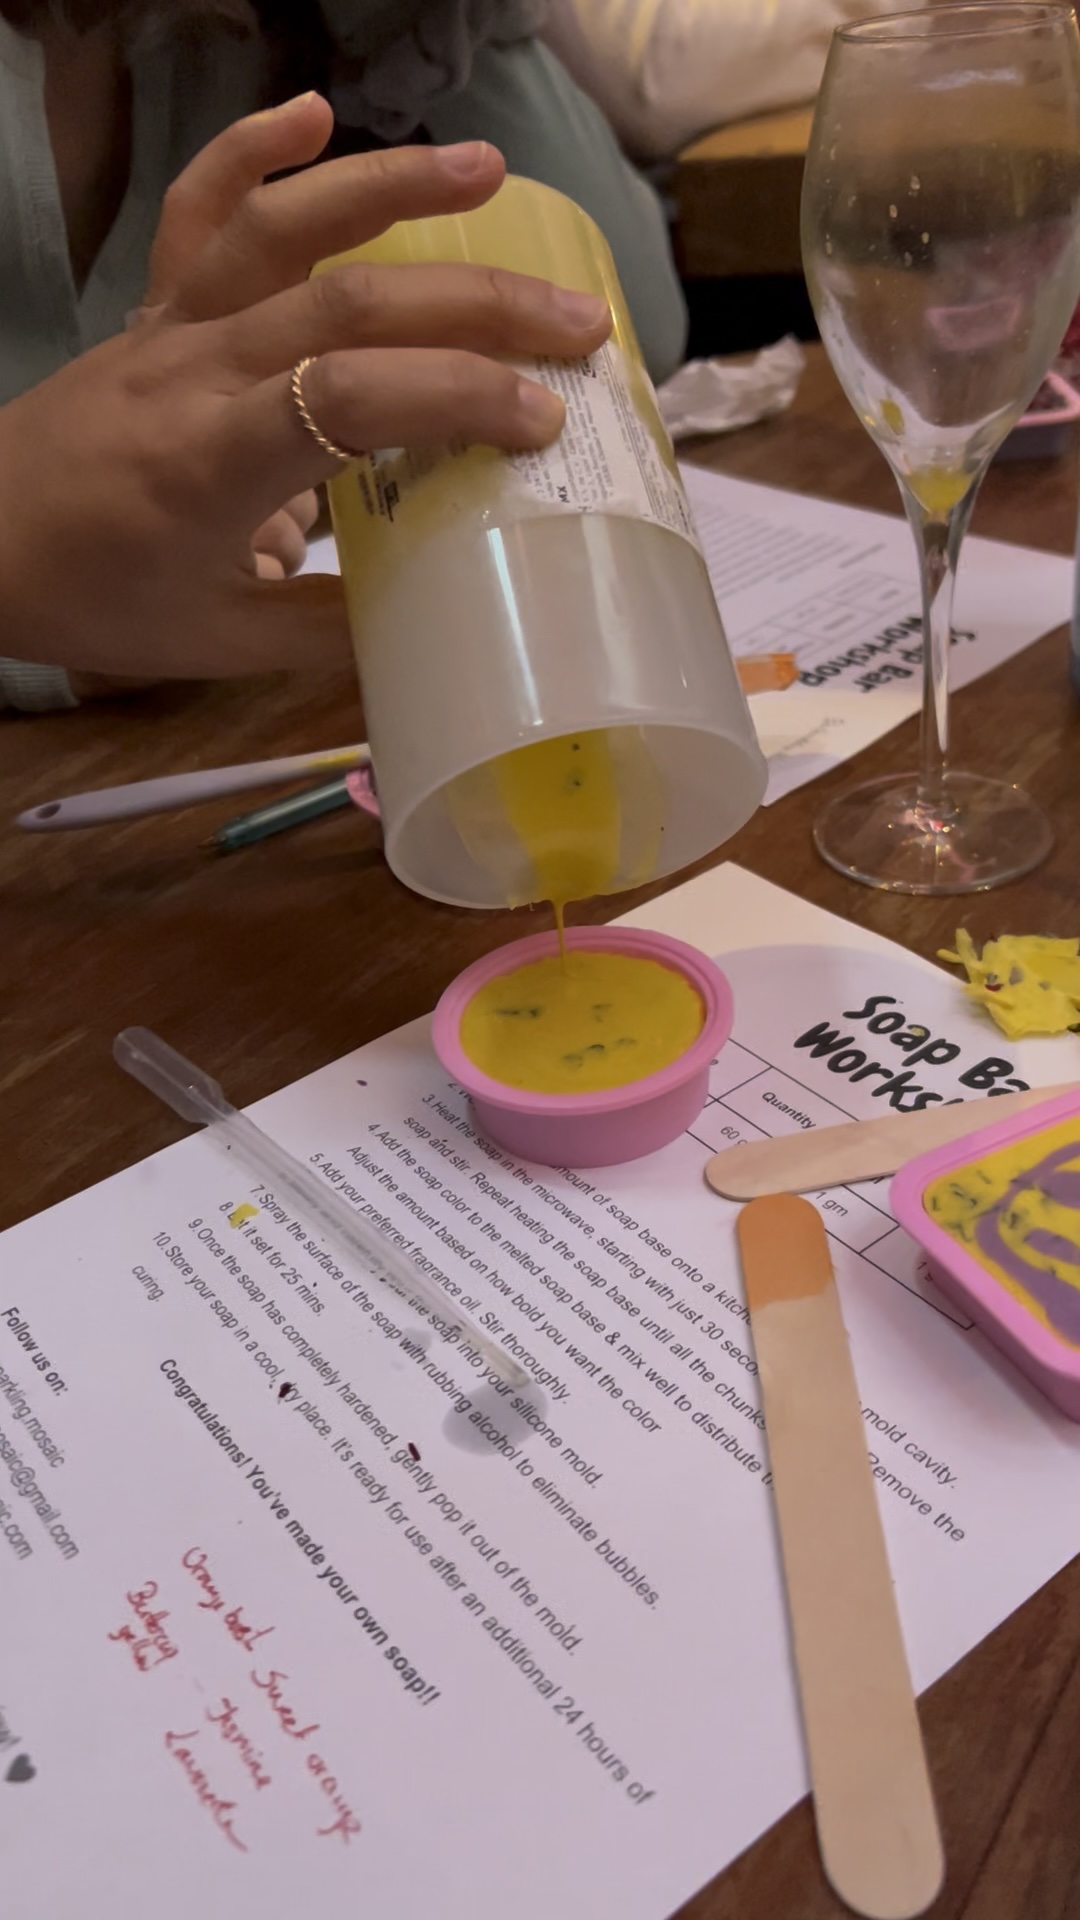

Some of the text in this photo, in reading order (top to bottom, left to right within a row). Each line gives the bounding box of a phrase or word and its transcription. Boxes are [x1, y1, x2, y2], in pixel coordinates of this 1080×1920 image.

[854, 664, 914, 694] Bar
[793, 1021, 965, 1114] Works
[842, 995, 962, 1068] Soap
[720, 1126, 740, 1141] 60
[761, 1092, 817, 1130] Quantity
[243, 1226, 258, 1238] it
[250, 1234, 275, 1256] set
[821, 1197, 849, 1218] gm
[132, 1264, 165, 1303] curing.
[267, 1251, 287, 1270] for
[280, 1267, 304, 1286] 25
[294, 1284, 326, 1317] mins.
[335, 1180, 366, 1206] your
[360, 1203, 415, 1251] preferred
[407, 1246, 463, 1297] fragrance
[459, 1295, 482, 1315] oil.
[479, 1311, 505, 1335] Stir
[500, 1333, 571, 1405] thoroughly.
[347, 1145, 662, 1434] Adjust the amount based on how bold you want the color
[403, 1115, 767, 1432] soap and stir. Repeat heating the soap base until all the chunks
[0, 1306, 69, 1397] Follow us on:
[396, 1146, 417, 1167] the
[414, 1165, 443, 1192] soap
[440, 1188, 472, 1216] color
[467, 1211, 483, 1227] to
[480, 1222, 503, 1243] the
[499, 1239, 546, 1277] melted
[540, 1272, 574, 1304] soap
[570, 1300, 607, 1334] base
[604, 1331, 621, 1347] &
[616, 1344, 647, 1370] mix
[644, 1367, 680, 1398] well
[673, 1393, 692, 1413] to
[691, 1411, 763, 1473] distribute
[455, 1119, 476, 1138] the
[473, 1137, 504, 1162] soap
[500, 1157, 514, 1171] in
[512, 1167, 533, 1187] the
[532, 1184, 595, 1240] microwave,
[597, 1236, 646, 1280] starting
[644, 1275, 676, 1303] with
[668, 1299, 704, 1325] just
[700, 1321, 724, 1340] 30
[932, 1511, 966, 1542] the
[592, 1193, 612, 1206] of
[606, 1205, 639, 1232] soap
[638, 1228, 672, 1258] base
[671, 1257, 703, 1284] onto
[702, 1282, 716, 1294] a
[861, 1407, 907, 1444] mold
[903, 1442, 957, 1489] cavity.
[286, 1221, 308, 1243] the
[303, 1240, 345, 1282] surface
[340, 1280, 362, 1295] of
[352, 1290, 375, 1314] the
[371, 1311, 403, 1341] soap
[399, 1337, 427, 1365] with
[422, 1362, 474, 1415] rubbing
[468, 1411, 523, 1462] alcohol
[515, 1457, 535, 1477] to
[531, 1476, 598, 1543] eliminate
[594, 1538, 661, 1611] bubbles.
[427, 1313, 461, 1345] soap
[456, 1340, 484, 1369] into
[476, 1366, 516, 1398] your
[510, 1397, 563, 1449] silicone
[560, 1446, 604, 1489] mold.
[0, 1426, 81, 1562] osaic@gmail.com
[221, 1254, 243, 1277] the
[237, 1274, 267, 1305] soap
[261, 1300, 287, 1326] has
[281, 1324, 342, 1387] completely
[336, 1382, 400, 1451] hardened,
[390, 1448, 438, 1494] gently
[428, 1492, 464, 1524] pop
[458, 1519, 478, 1537] it
[470, 1534, 502, 1562] out
[493, 1560, 521, 1579] of
[509, 1575, 540, 1608] the
[534, 1605, 584, 1657] mold.
[159, 1358, 442, 1707] Congratulations! You've made your own soap!!
[184, 1274, 217, 1301] your
[209, 1299, 239, 1329] soap
[233, 1325, 251, 1343] in
[244, 1340, 259, 1353] a
[253, 1351, 286, 1384] cool,
[279, 1382, 303, 1403] ry
[292, 1401, 333, 1441] place.
[331, 1437, 355, 1463] It's
[349, 1461, 391, 1505] ready
[384, 1500, 411, 1526] for
[404, 1524, 434, 1556] use
[428, 1554, 467, 1592] after
[461, 1592, 487, 1617] an
[480, 1615, 563, 1701] additional
[552, 1695, 585, 1726] 24
[575, 1721, 630, 1783] hours
[625, 1780, 658, 1805] of
[250, 1669, 321, 1741] Sweet
